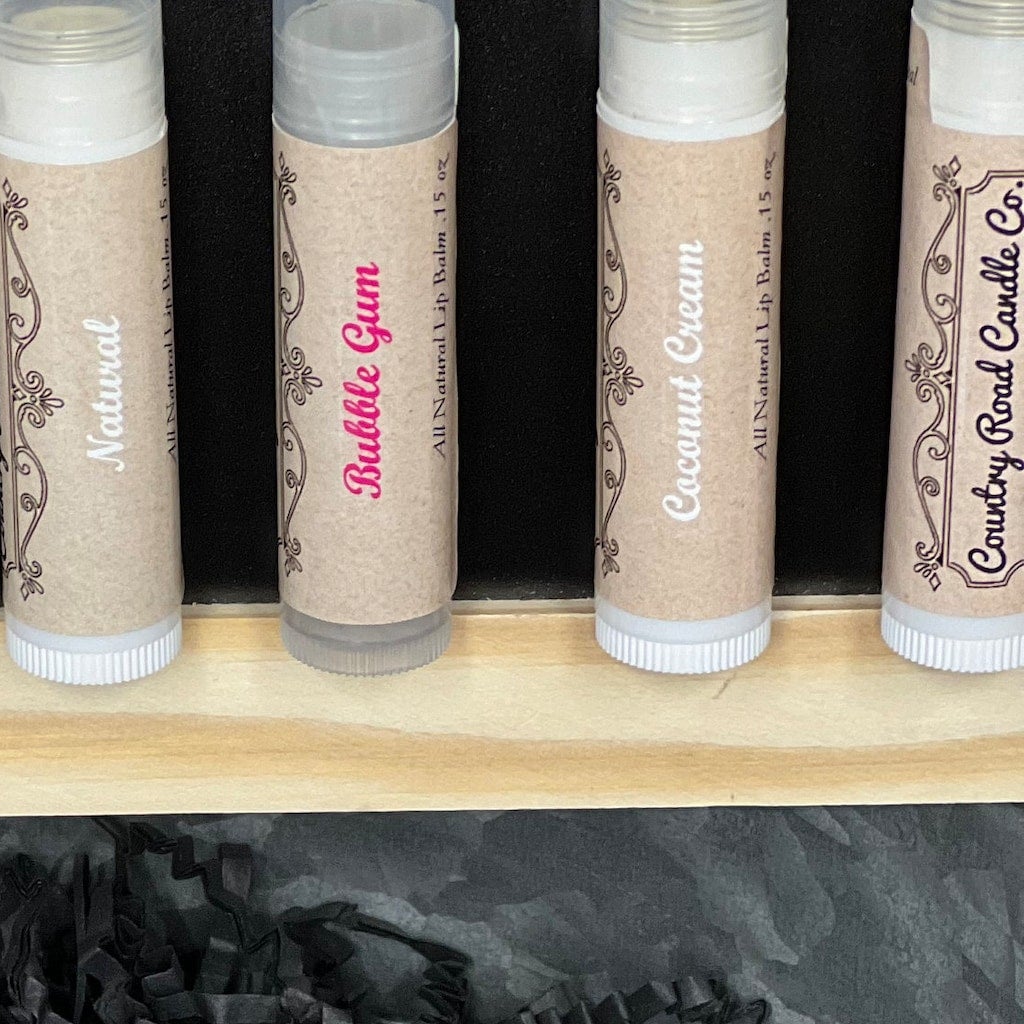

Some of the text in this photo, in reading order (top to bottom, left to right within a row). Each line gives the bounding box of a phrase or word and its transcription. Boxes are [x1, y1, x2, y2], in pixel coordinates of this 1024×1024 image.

[82, 315, 125, 472] Natural
[341, 263, 393, 500] Bubble Gum
[432, 152, 450, 460] All Natural Lip Balm .15 oz
[662, 240, 704, 522] Coconut Cream
[753, 151, 777, 461] All Natural Lip Balm .15 oz
[967, 180, 1024, 574] Country Road Candle Co.
